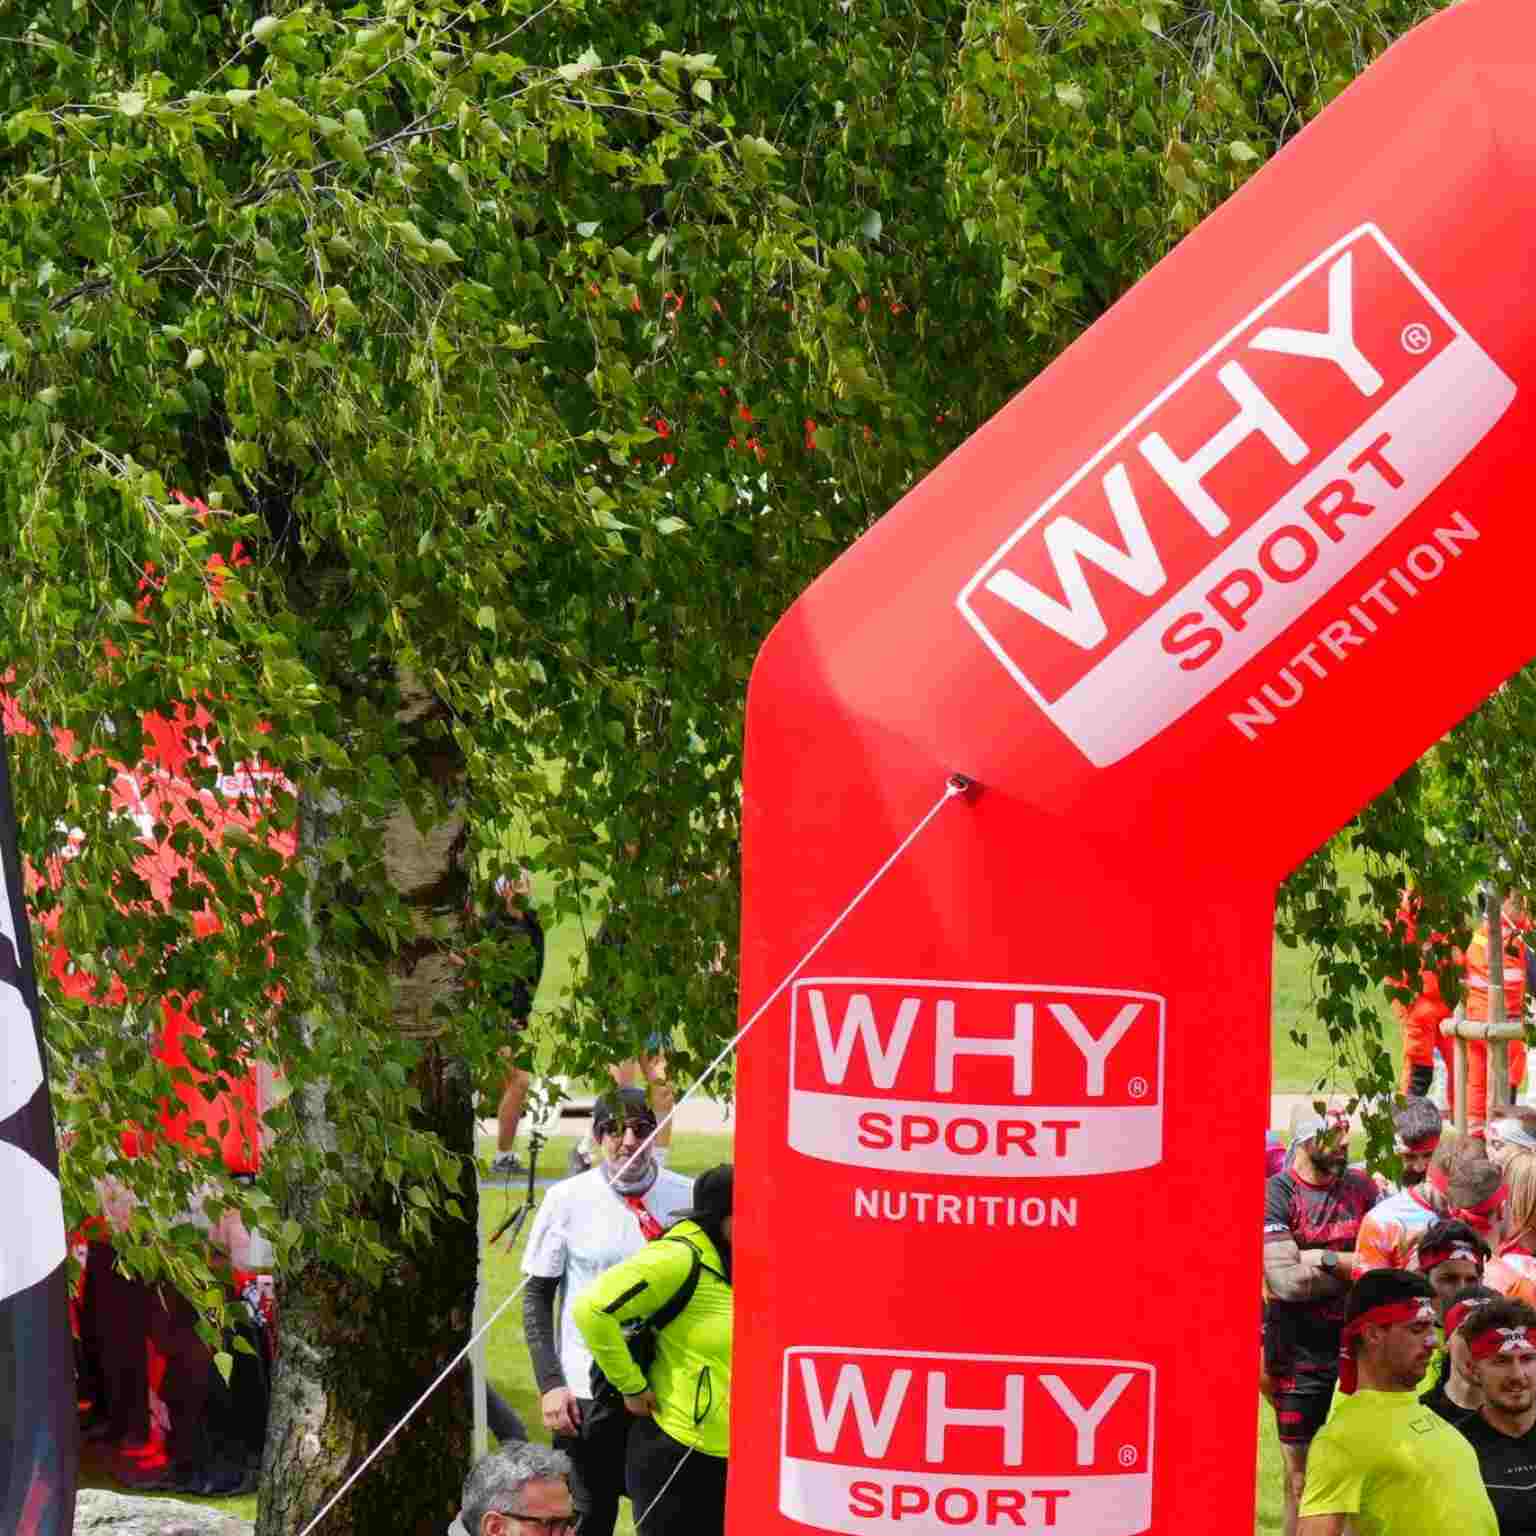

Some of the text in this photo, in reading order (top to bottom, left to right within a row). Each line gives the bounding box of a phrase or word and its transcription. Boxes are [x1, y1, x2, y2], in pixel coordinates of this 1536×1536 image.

[1159, 431, 1404, 671] SPORT
[1228, 509, 1480, 742] NUTRITION
[858, 1113, 1080, 1157] SPORT
[855, 1188, 1077, 1226] NUTRITION
[848, 1481, 1070, 1526] SPORT
